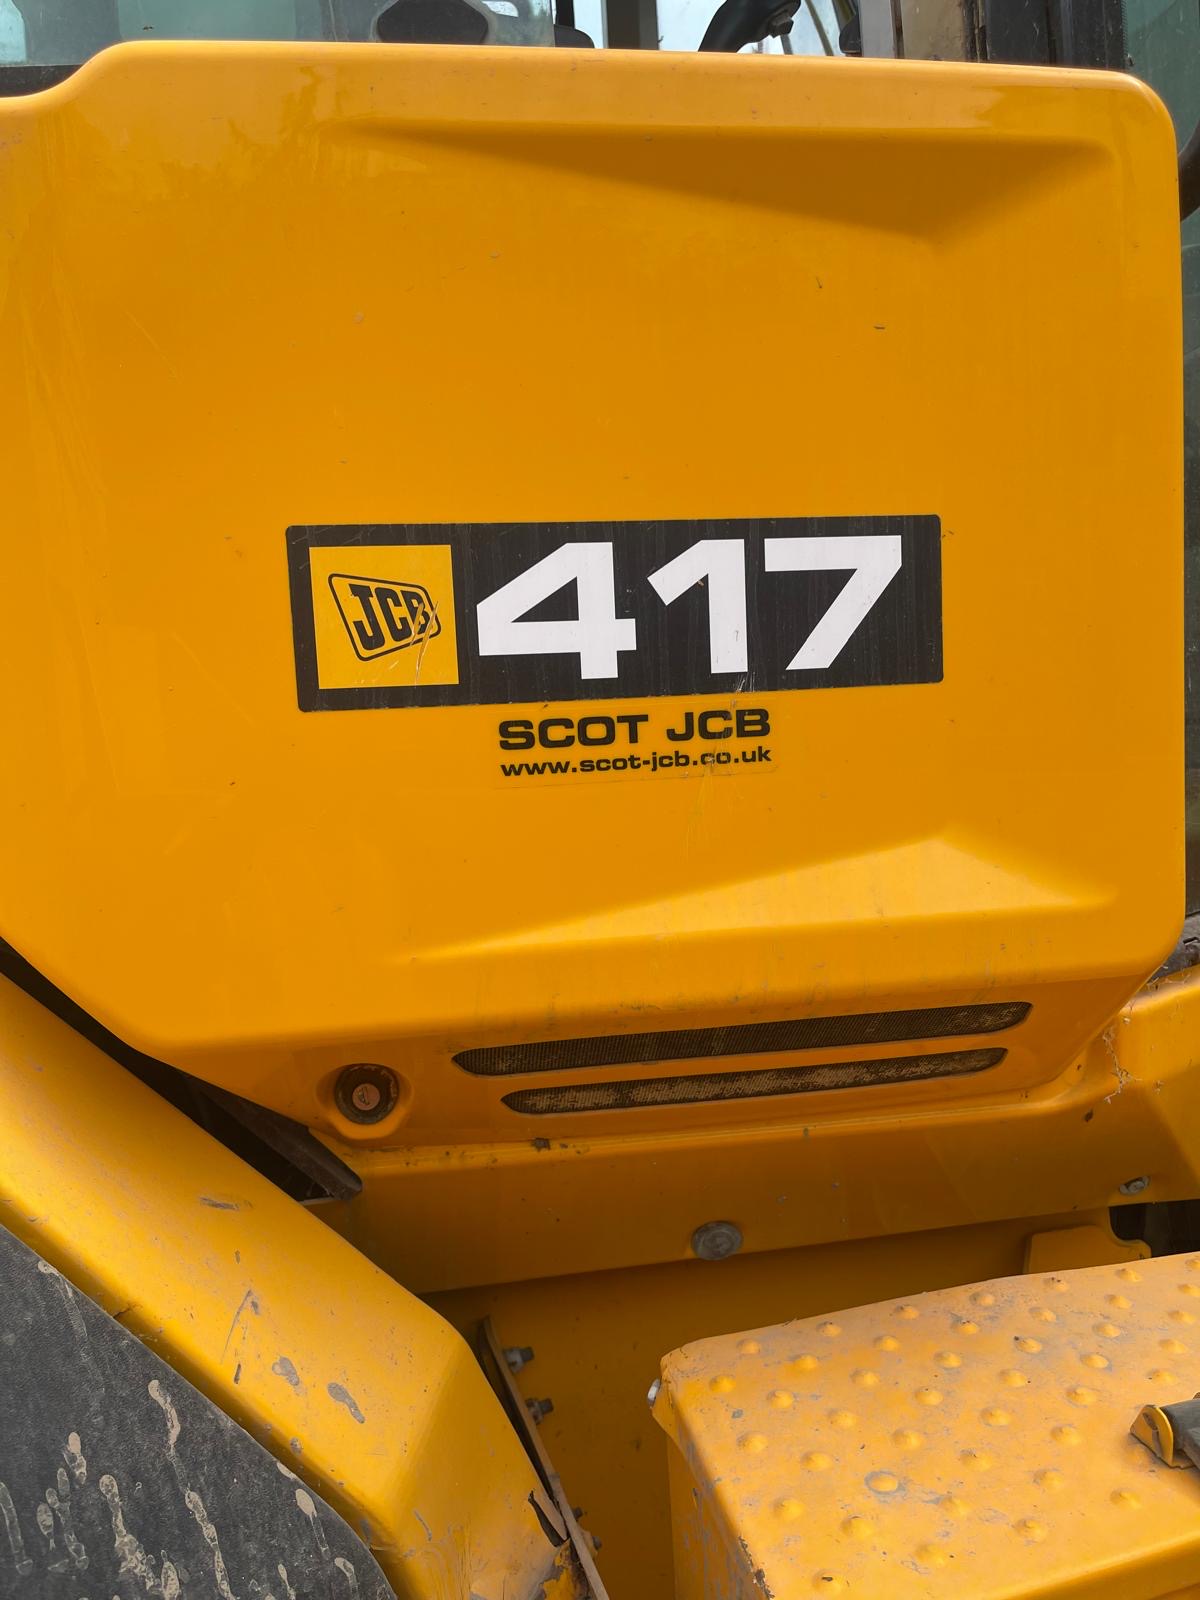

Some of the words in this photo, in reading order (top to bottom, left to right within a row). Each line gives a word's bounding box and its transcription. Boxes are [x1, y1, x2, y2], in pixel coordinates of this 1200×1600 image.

[348, 583, 432, 651] JCB
[476, 535, 902, 680] 417
[499, 714, 649, 750] SCOT
[666, 708, 771, 742] JCB
[500, 746, 772, 777] www.scot-jcb.co.uk
